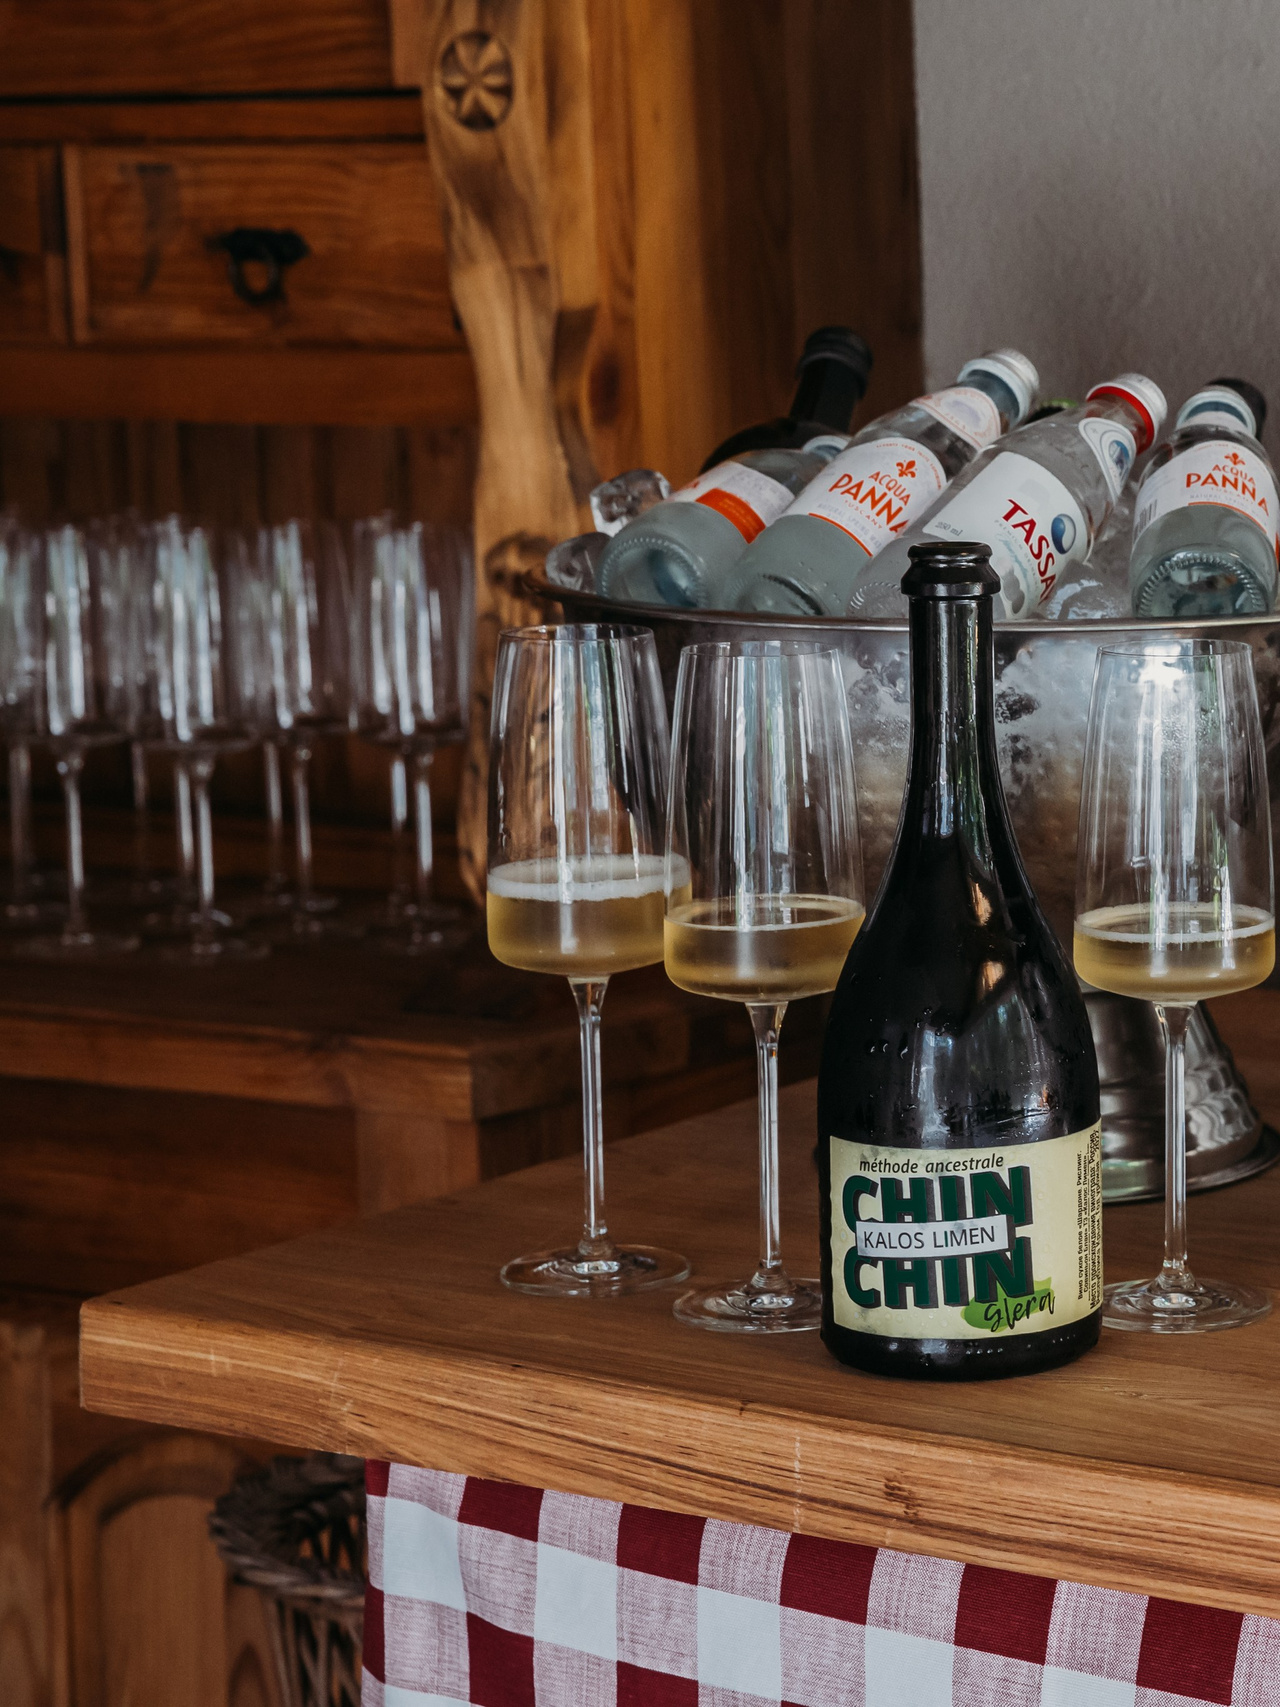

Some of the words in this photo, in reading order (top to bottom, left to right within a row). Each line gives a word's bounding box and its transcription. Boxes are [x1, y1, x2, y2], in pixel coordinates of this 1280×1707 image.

[868, 471, 911, 506] ACQUA
[1212, 463, 1256, 486] ACQUA
[1186, 472, 1269, 517] PANNA
[859, 1157, 919, 1174] méthode
[925, 1153, 1004, 1174] ancestrale
[842, 1165, 1034, 1233] CHIN
[863, 1230, 925, 1250] KALOS
[933, 1225, 996, 1248] LIMEN
[843, 1236, 1035, 1309] CHIN
